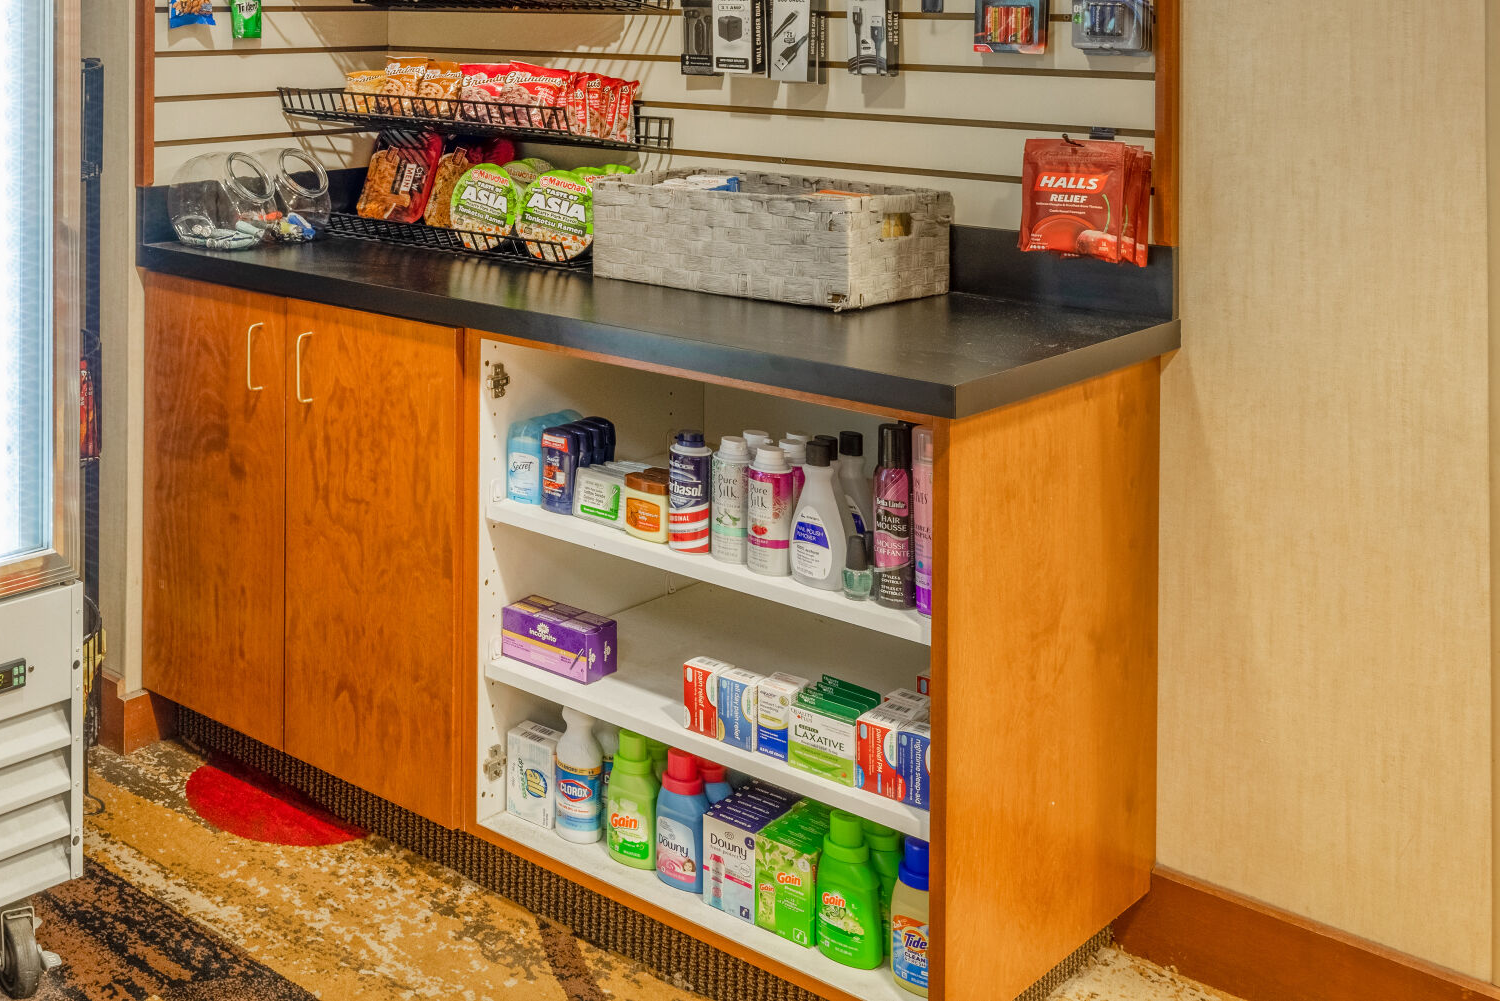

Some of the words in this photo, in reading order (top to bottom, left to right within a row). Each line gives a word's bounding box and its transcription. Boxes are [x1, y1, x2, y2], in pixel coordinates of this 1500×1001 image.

[478, 170, 509, 187] Maruchan
[548, 176, 587, 195] Maruchan
[1040, 176, 1099, 190] HALLS
[460, 187, 507, 213] ASIA
[546, 188, 569, 198] TASTE
[1050, 194, 1088, 203] RELIEF
[458, 205, 487, 221] Tonkotsu
[487, 216, 505, 226] Ramen
[526, 193, 586, 223] ASIA
[524, 213, 557, 229] Tonkotsu
[558, 223, 583, 235] Ramen
[512, 462, 533, 472] Secret
[718, 473, 738, 486] Pure
[718, 483, 738, 499] Silk
[750, 483, 768, 496] Pure
[750, 493, 767, 509] Silk
[876, 521, 907, 532] MOUSSE
[881, 516, 900, 524] HAIR
[876, 540, 907, 549] MOUSSE
[529, 628, 557, 643] incognito
[794, 725, 845, 752] LAXATIVE
[560, 782, 589, 799] CLOROX
[610, 812, 638, 830] Gain
[658, 834, 689, 858] Downy
[710, 832, 747, 860] Downy
[776, 872, 801, 886] Gain
[759, 883, 775, 892] Gain
[822, 892, 846, 907] Gain
[904, 932, 928, 949] Tide
[904, 951, 926, 963] CLEAN
